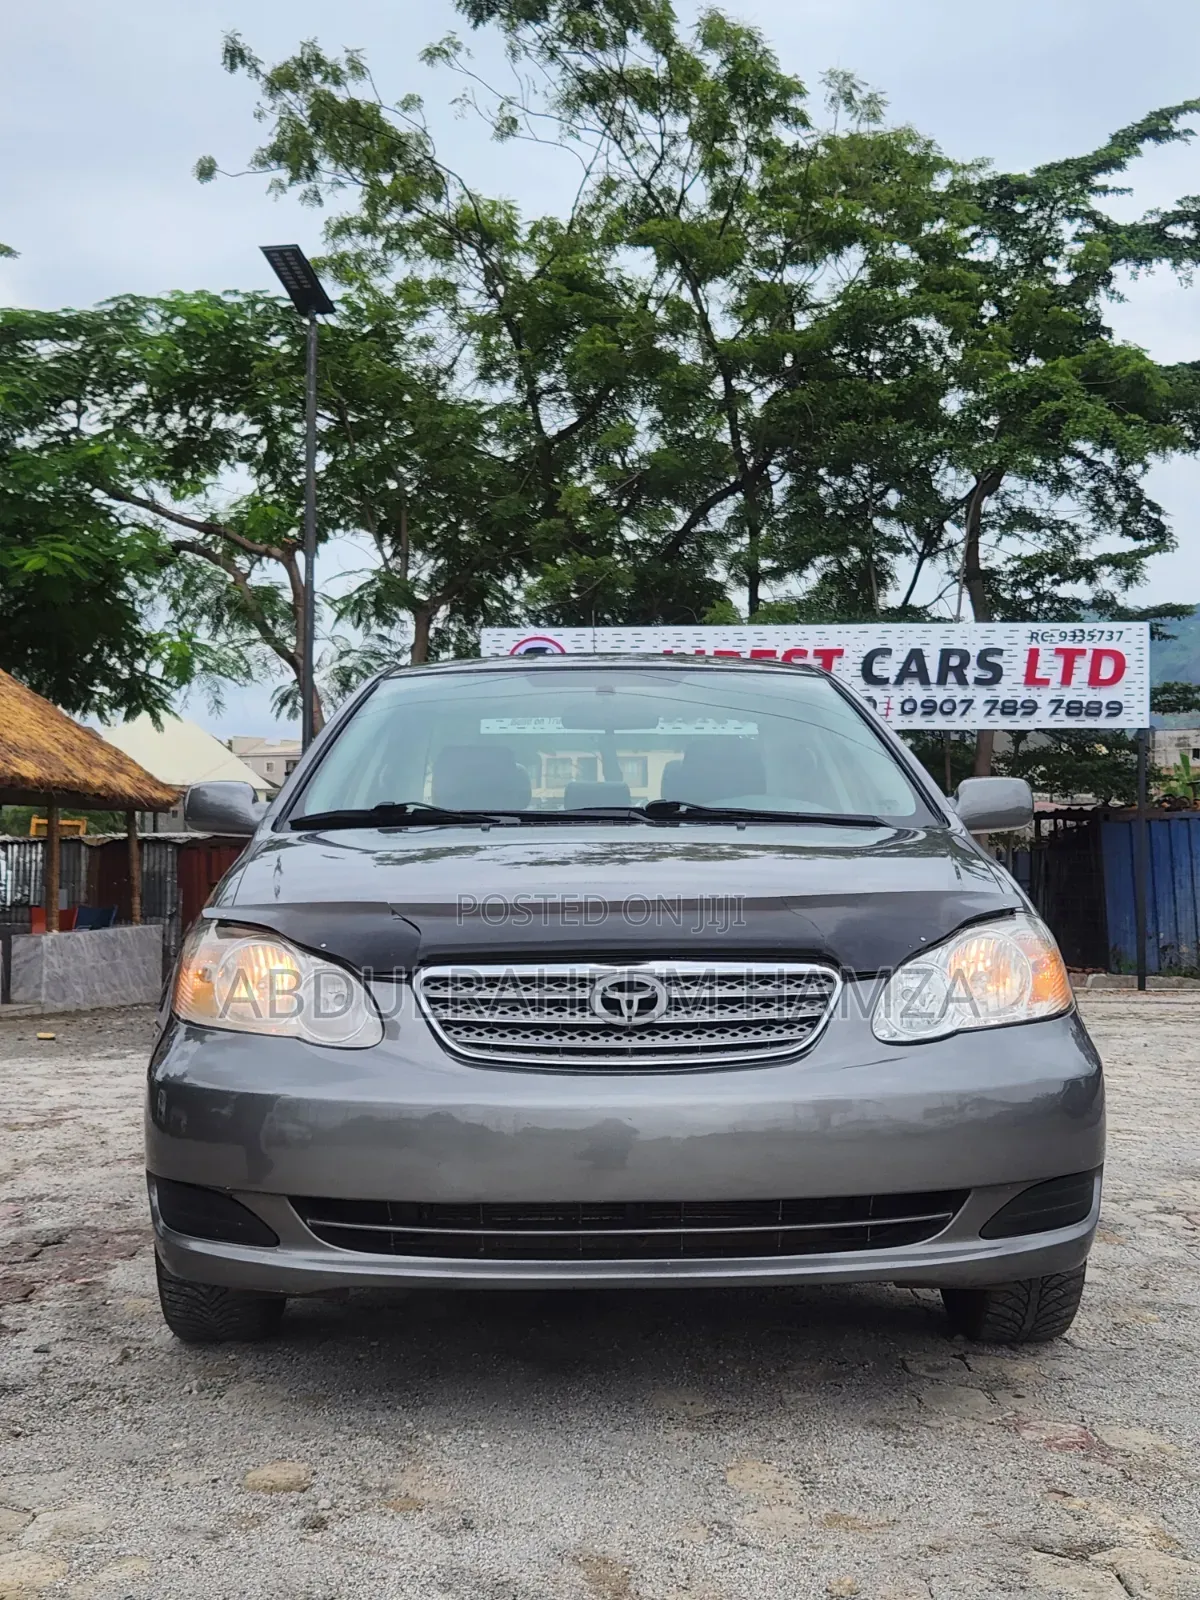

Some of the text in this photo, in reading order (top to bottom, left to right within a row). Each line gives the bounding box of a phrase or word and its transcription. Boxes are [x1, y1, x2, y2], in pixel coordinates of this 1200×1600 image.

[861, 647, 1004, 686] CARS
[1023, 647, 1126, 687] LTD
[900, 698, 974, 717] 0907
[982, 699, 1038, 717] 789
[1048, 699, 1123, 718] 7889
